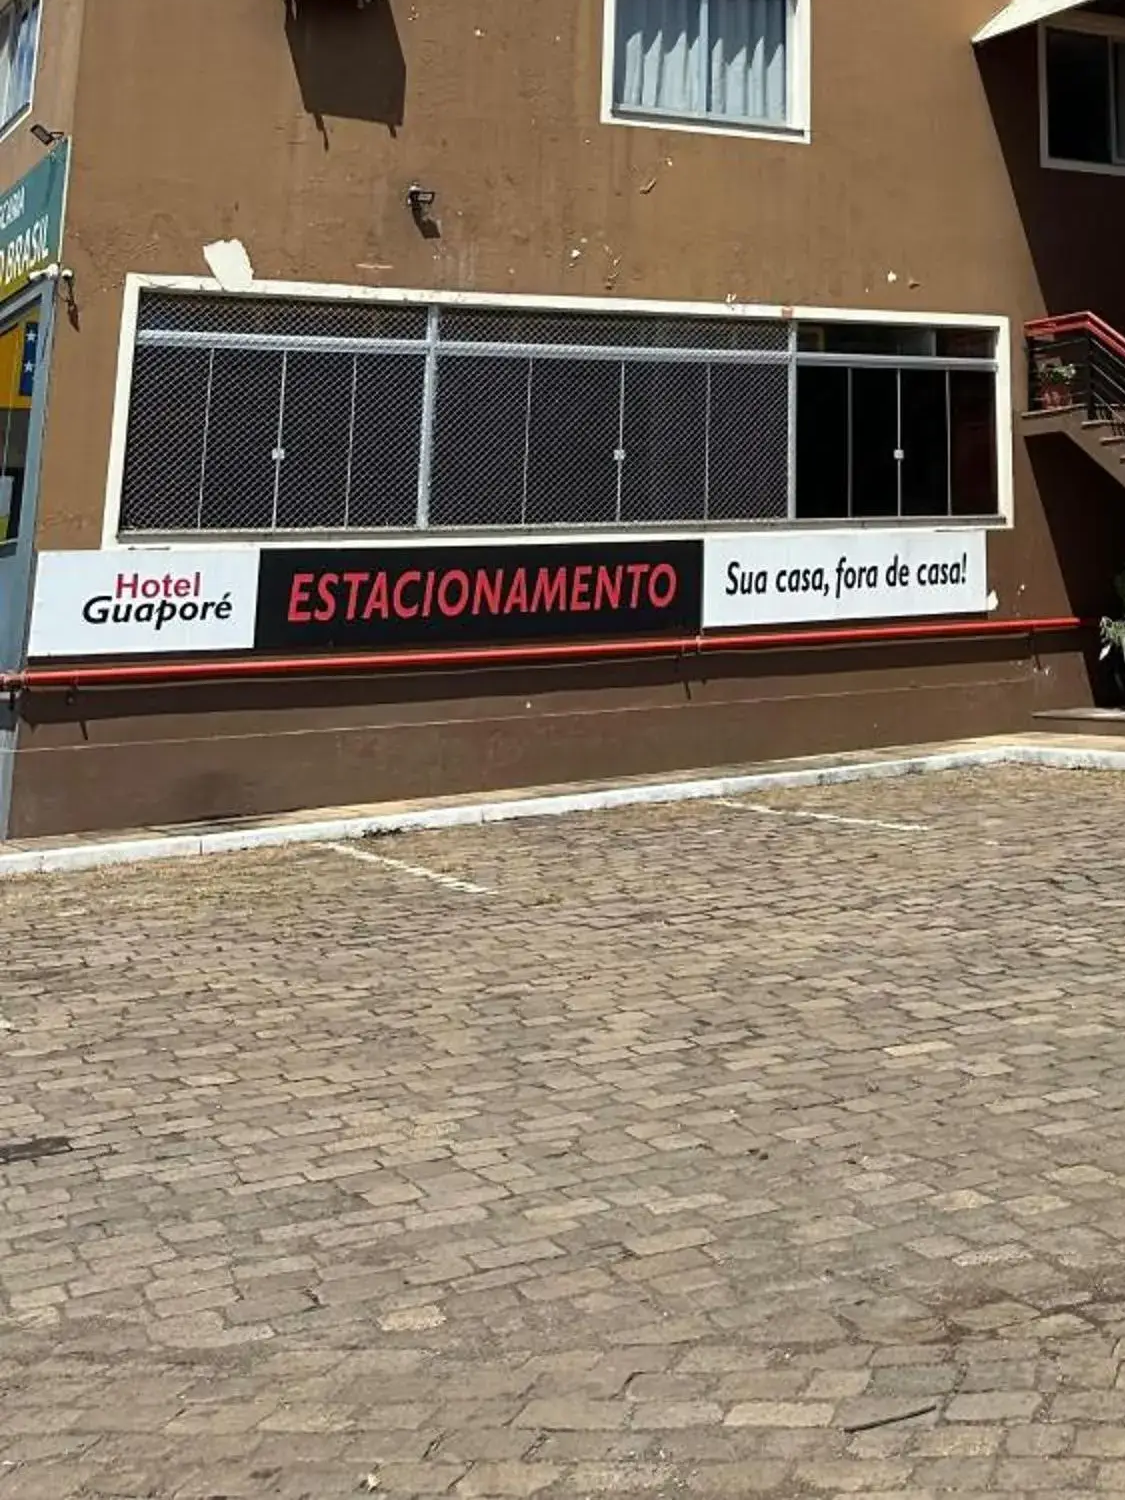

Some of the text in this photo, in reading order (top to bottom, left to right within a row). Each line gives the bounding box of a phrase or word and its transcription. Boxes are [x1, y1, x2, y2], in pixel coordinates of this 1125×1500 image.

[5, 213, 49, 285] BRASIL
[116, 571, 201, 599] Hotel
[286, 562, 678, 623] ESTACIONAMENTO
[725, 552, 968, 599] Sua casa, fora de casa!
[82, 592, 233, 630] Guaporé
